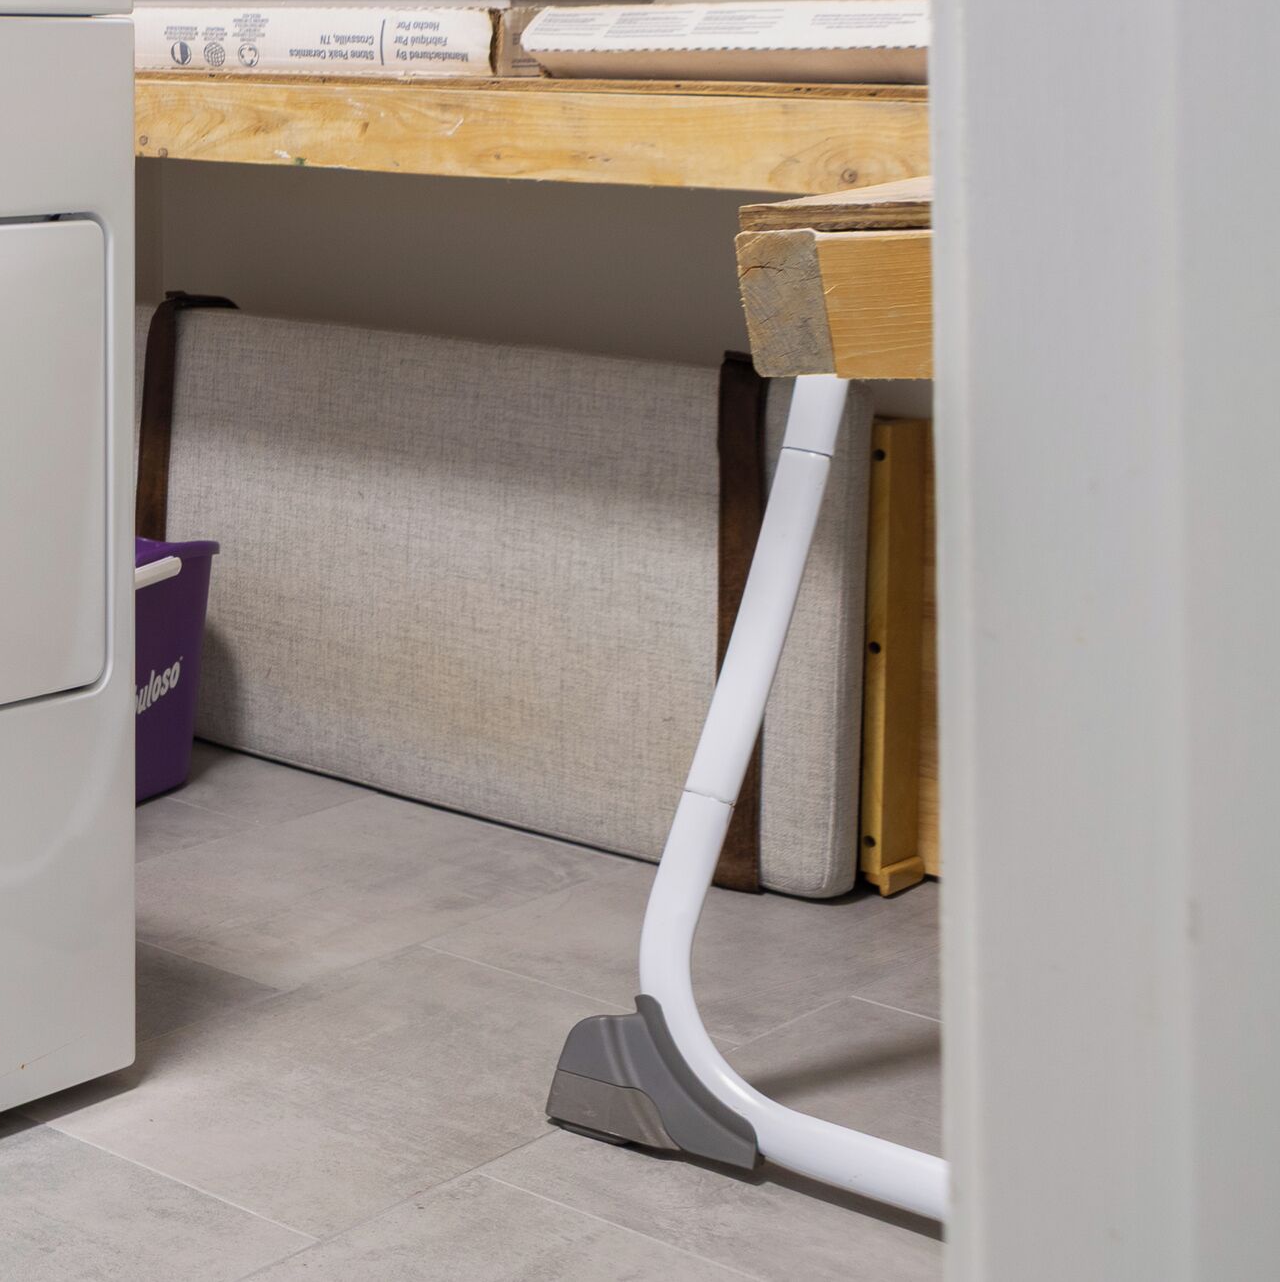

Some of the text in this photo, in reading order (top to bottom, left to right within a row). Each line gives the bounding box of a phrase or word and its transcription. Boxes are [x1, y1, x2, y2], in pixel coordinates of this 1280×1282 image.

[396, 20, 440, 32] Hecho Por
[320, 33, 375, 46] Crossville, TN
[394, 35, 408, 47] Par
[289, 48, 375, 61] Stone Peak Ceramics
[396, 48, 469, 63] Manufactured By
[135, 660, 181, 715] uloso
